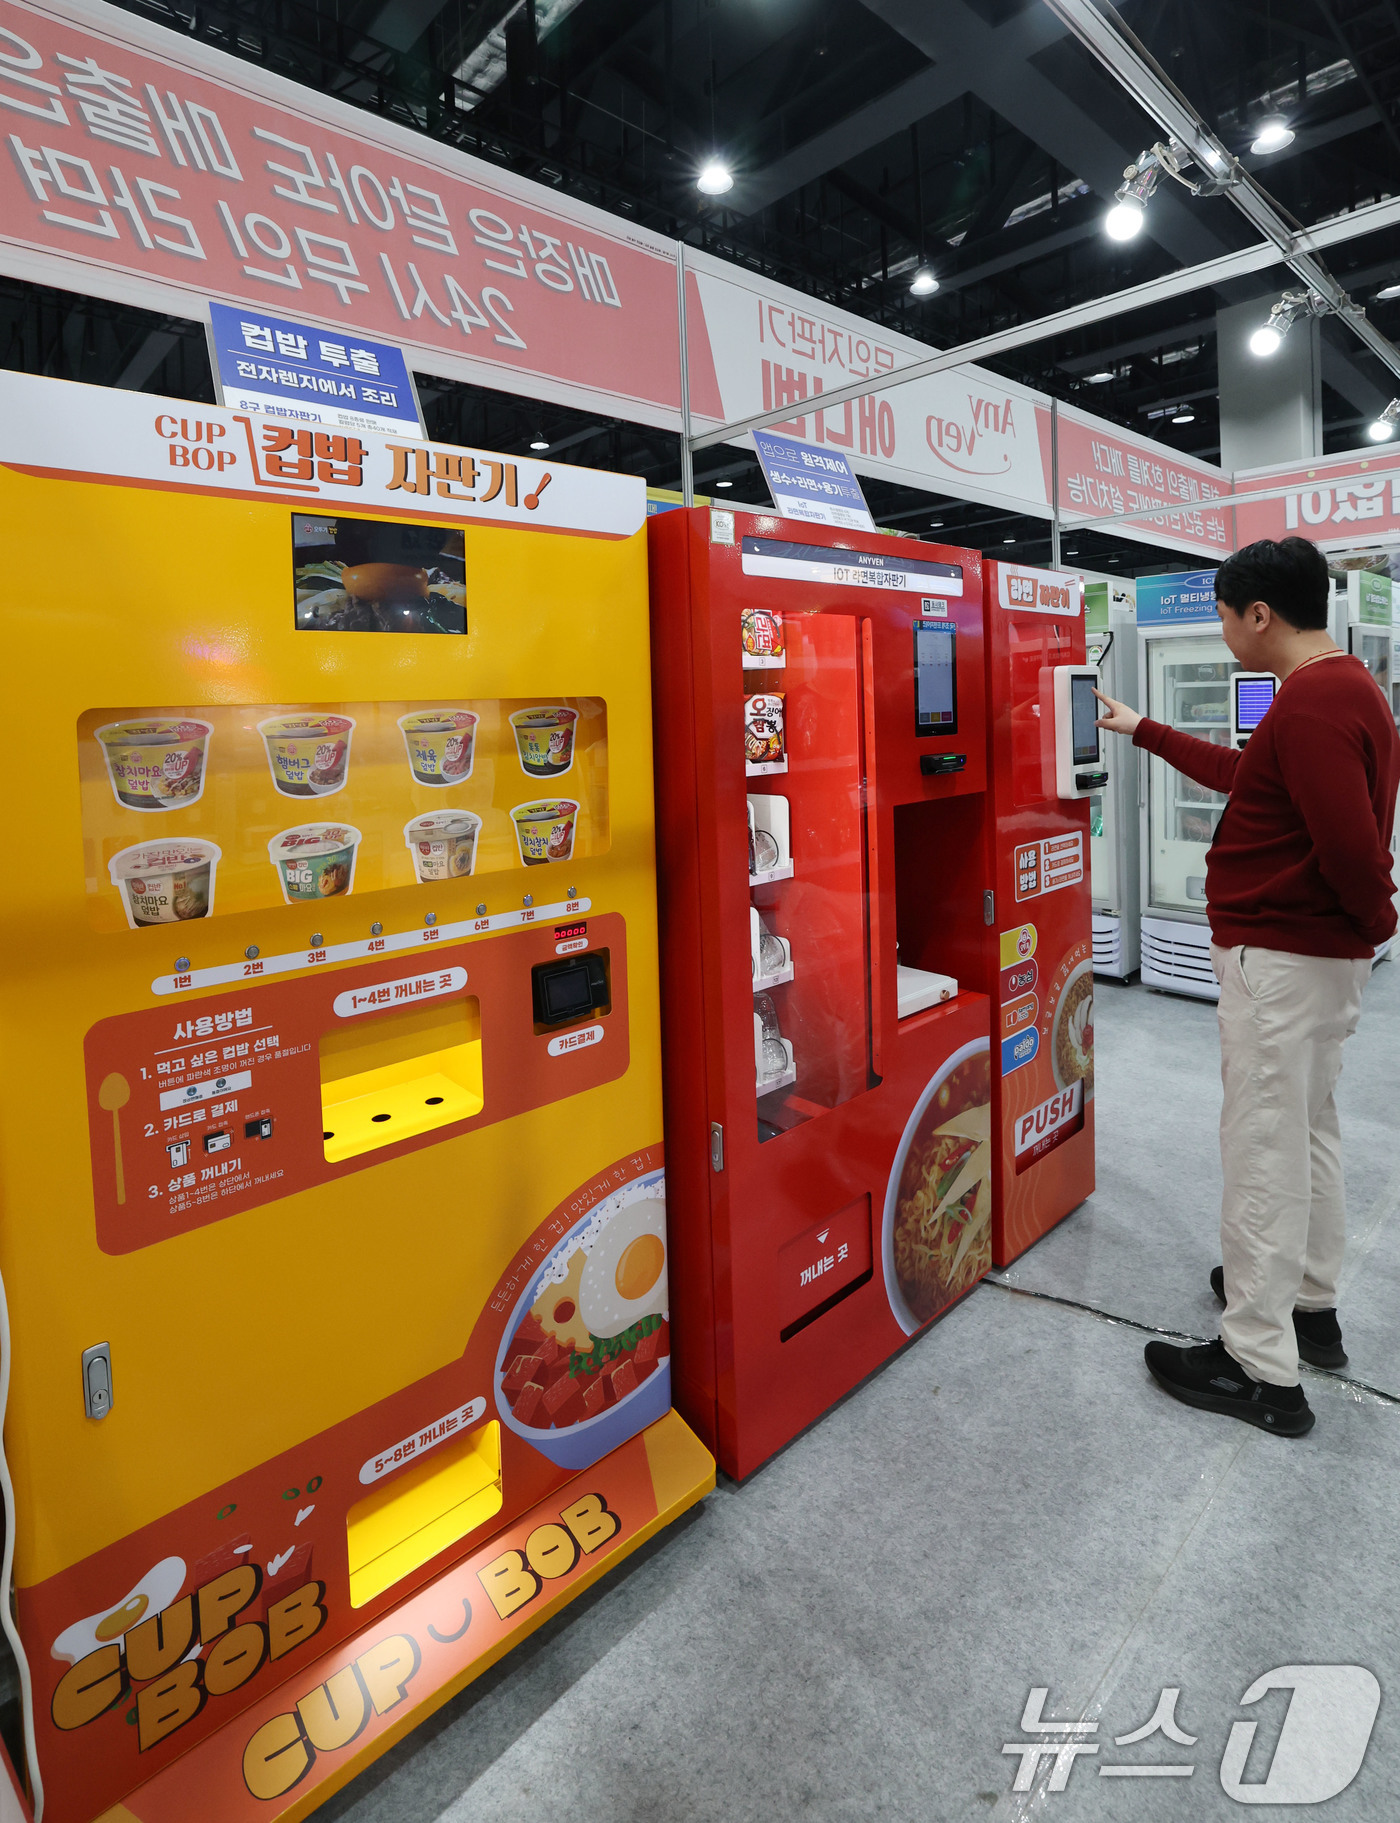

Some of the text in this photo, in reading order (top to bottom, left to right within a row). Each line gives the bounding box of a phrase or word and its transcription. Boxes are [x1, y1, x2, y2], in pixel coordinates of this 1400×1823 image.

[240, 322, 380, 376] 컵밥 투출
[236, 360, 398, 407] 전자렌지에서 조리
[155, 414, 226, 444] CUP
[169, 444, 236, 471] BOP
[262, 423, 370, 486] 컵밥
[760, 442, 848, 475] 앱으로 원격제어
[858, 556, 884, 566] ANYVEN
[833, 568, 907, 588] IOT 라면복합자판기
[1011, 578, 1070, 609] 라면 자판기
[1161, 595, 1177, 604] IoT
[1174, 605, 1212, 613] Freezing
[114, 763, 161, 777] 참치마요
[276, 754, 310, 769] 햄버그
[416, 749, 437, 763] 제육
[421, 762, 435, 772] 덮밥
[128, 779, 150, 791] 덮밥
[286, 770, 304, 780] 덮밥
[1020, 850, 1036, 870] 사용
[286, 870, 312, 883] BIG
[1020, 871, 1037, 892] 방법
[132, 895, 168, 906] 참치마요
[141, 906, 159, 916] 덮밥
[172, 901, 579, 990] 1번 2번 3번 4번 5번 6번 7번 8번
[562, 942, 583, 951] 금액확인
[350, 975, 452, 1010] 1~4번 꺼내는 곳
[173, 1008, 253, 1041] 사용방법
[559, 1030, 595, 1050] 카드결제
[140, 1035, 280, 1080] 1. 먹고 싶은 컵밥 선택
[159, 1043, 311, 1088] 버튼에 파란색 조명이 꺼진 경우 품절입니다
[144, 1100, 238, 1137] 2. 카드로 결제
[1021, 1088, 1074, 1146] PUSH
[148, 1158, 242, 1198] 3. 상품 꺼내기
[218, 1171, 250, 1187] 상단에서
[220, 1181, 252, 1196] 하단에서
[255, 1169, 284, 1185] 꺼내세요
[491, 1256, 534, 1312] 든든하게
[534, 1238, 548, 1252] 한
[571, 1180, 610, 1214] 맛있게
[613, 1168, 626, 1181] 한
[800, 1243, 848, 1286] 꺼내는 곳
[375, 1406, 473, 1473] 5~8번 꺼내는 곳
[51, 1564, 263, 1730] CUP
[242, 1493, 621, 1800] CUP BOB
[136, 1580, 328, 1754] BOB
